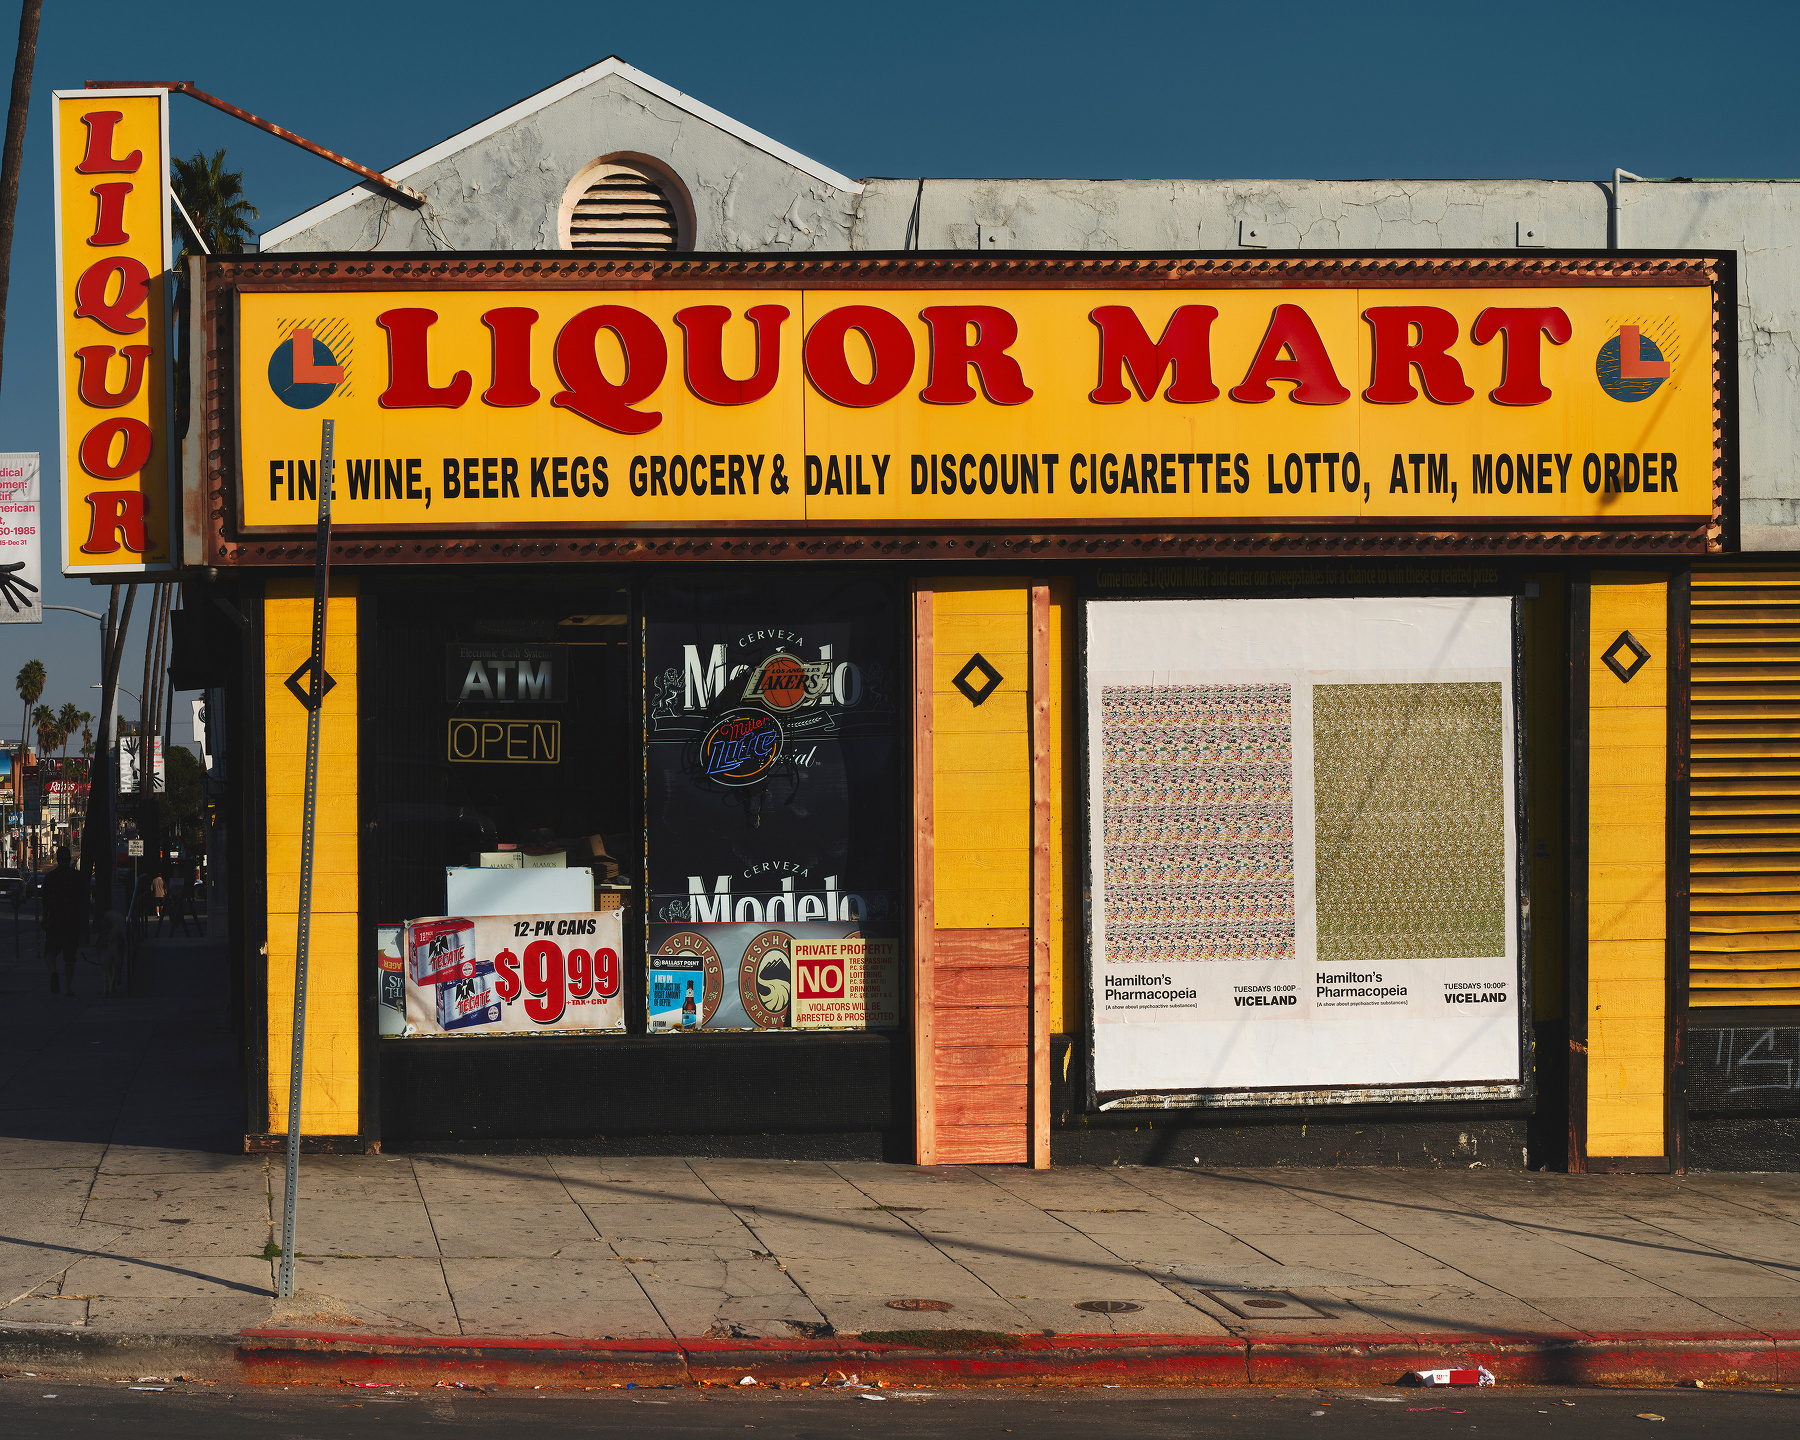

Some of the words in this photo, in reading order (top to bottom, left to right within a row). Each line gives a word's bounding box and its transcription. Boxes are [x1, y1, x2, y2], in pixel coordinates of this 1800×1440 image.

[75, 110, 157, 554] LIQUOR
[376, 304, 1033, 435] LIQUOR
[1088, 303, 1572, 406] MART
[346, 459, 431, 510] WINE,
[444, 458, 519, 498] BEER
[531, 456, 609, 497] KEGS
[630, 454, 765, 497] GROCERY
[770, 454, 789, 495] &
[805, 455, 890, 496] DAILY
[912, 454, 1058, 495] DISCOUNT
[1070, 453, 1249, 494] CIGARETTES
[1269, 452, 1370, 504] LOTTO,
[1390, 454, 1457, 504] ATM,
[1473, 453, 1572, 494] MONEY
[1582, 453, 1677, 494] ORDER
[1097, 567, 1121, 588] Come
[1122, 566, 1148, 588] inside
[1149, 566, 1183, 590] LIQUOR
[1185, 566, 1210, 588] MART
[1211, 565, 1227, 587] and
[1229, 567, 1253, 587] enter
[1254, 571, 1269, 586] our
[1270, 564, 1324, 590] sweepstakes
[1326, 563, 1338, 585] for
[1346, 563, 1376, 585] chance
[1377, 564, 1388, 584] to
[1388, 563, 1405, 584] win
[1405, 562, 1430, 584] these
[1430, 568, 1440, 583] or
[1441, 562, 1471, 584] related
[1474, 563, 1498, 588] prizes
[738, 629, 804, 648] CERVEZA
[460, 647, 499, 658] Electronic
[501, 647, 520, 658] Cash
[459, 660, 552, 700] ATM
[682, 643, 863, 711] Mlo
[752, 669, 822, 696] LAKERS
[720, 717, 770, 742] Miller
[453, 722, 556, 760] OPEN
[705, 731, 777, 775] Lite
[743, 860, 810, 879] CERVEZA
[513, 920, 555, 937] 12-PK
[557, 918, 597, 936] CANS
[429, 946, 466, 972] TECATE
[664, 935, 719, 975] SCHUTES
[796, 945, 838, 956] PRIVATE
[840, 944, 894, 955] PROPERTY
[383, 959, 403, 970] AGER
[849, 957, 892, 965] TRESPASSING
[798, 964, 843, 994] NO
[850, 971, 883, 979] LOITERING
[1105, 973, 1172, 987] Hamilton’s
[1316, 971, 1383, 984] Hamilton’s
[850, 985, 881, 993] DRINKING
[1105, 987, 1197, 1002] Pharmacopeia
[1234, 985, 1272, 993] TUESDAYS
[1316, 985, 1408, 998] Pharmacopeia
[1444, 992, 1507, 1004] VICELAND
[456, 990, 491, 1015] TECATE
[808, 1003, 851, 1012] VIOLATORS
[851, 1002, 870, 1011] WILL
[871, 1002, 881, 1011] BE
[1234, 995, 1297, 1007] VICELAND
[749, 1004, 786, 1025] BREWE
[796, 1013, 835, 1022] ARRESTED
[836, 1013, 843, 1022] &
[844, 1012, 894, 1022] PROSECUTED
